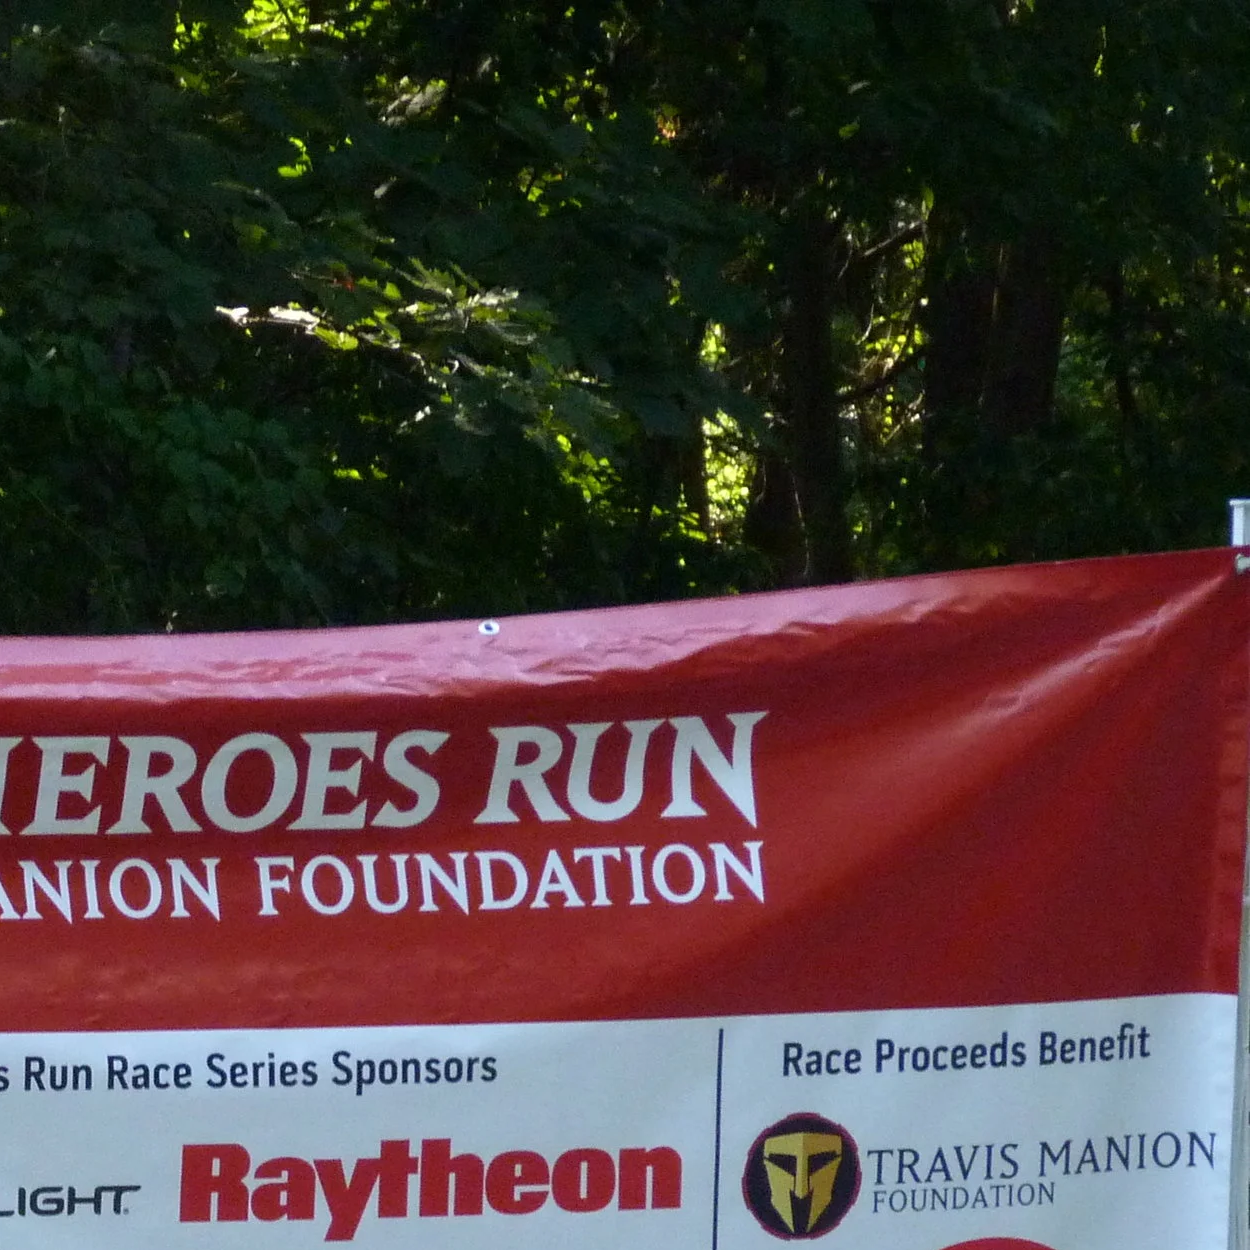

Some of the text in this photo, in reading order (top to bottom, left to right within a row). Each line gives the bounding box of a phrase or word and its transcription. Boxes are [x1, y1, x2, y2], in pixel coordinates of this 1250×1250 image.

[473, 710, 768, 828] RUN
[255, 840, 765, 917] FOUNDATION
[23, 1058, 92, 1091] Run
[107, 1056, 192, 1090] Race
[206, 1053, 318, 1087] Series
[331, 1051, 497, 1096] Sponsors
[783, 1023, 1150, 1076] Race Proceeds Benefit
[867, 1132, 1217, 1185] TRAVIS MANION
[179, 1138, 682, 1242] Raytheon
[872, 1181, 1056, 1214] FOUNDATION
